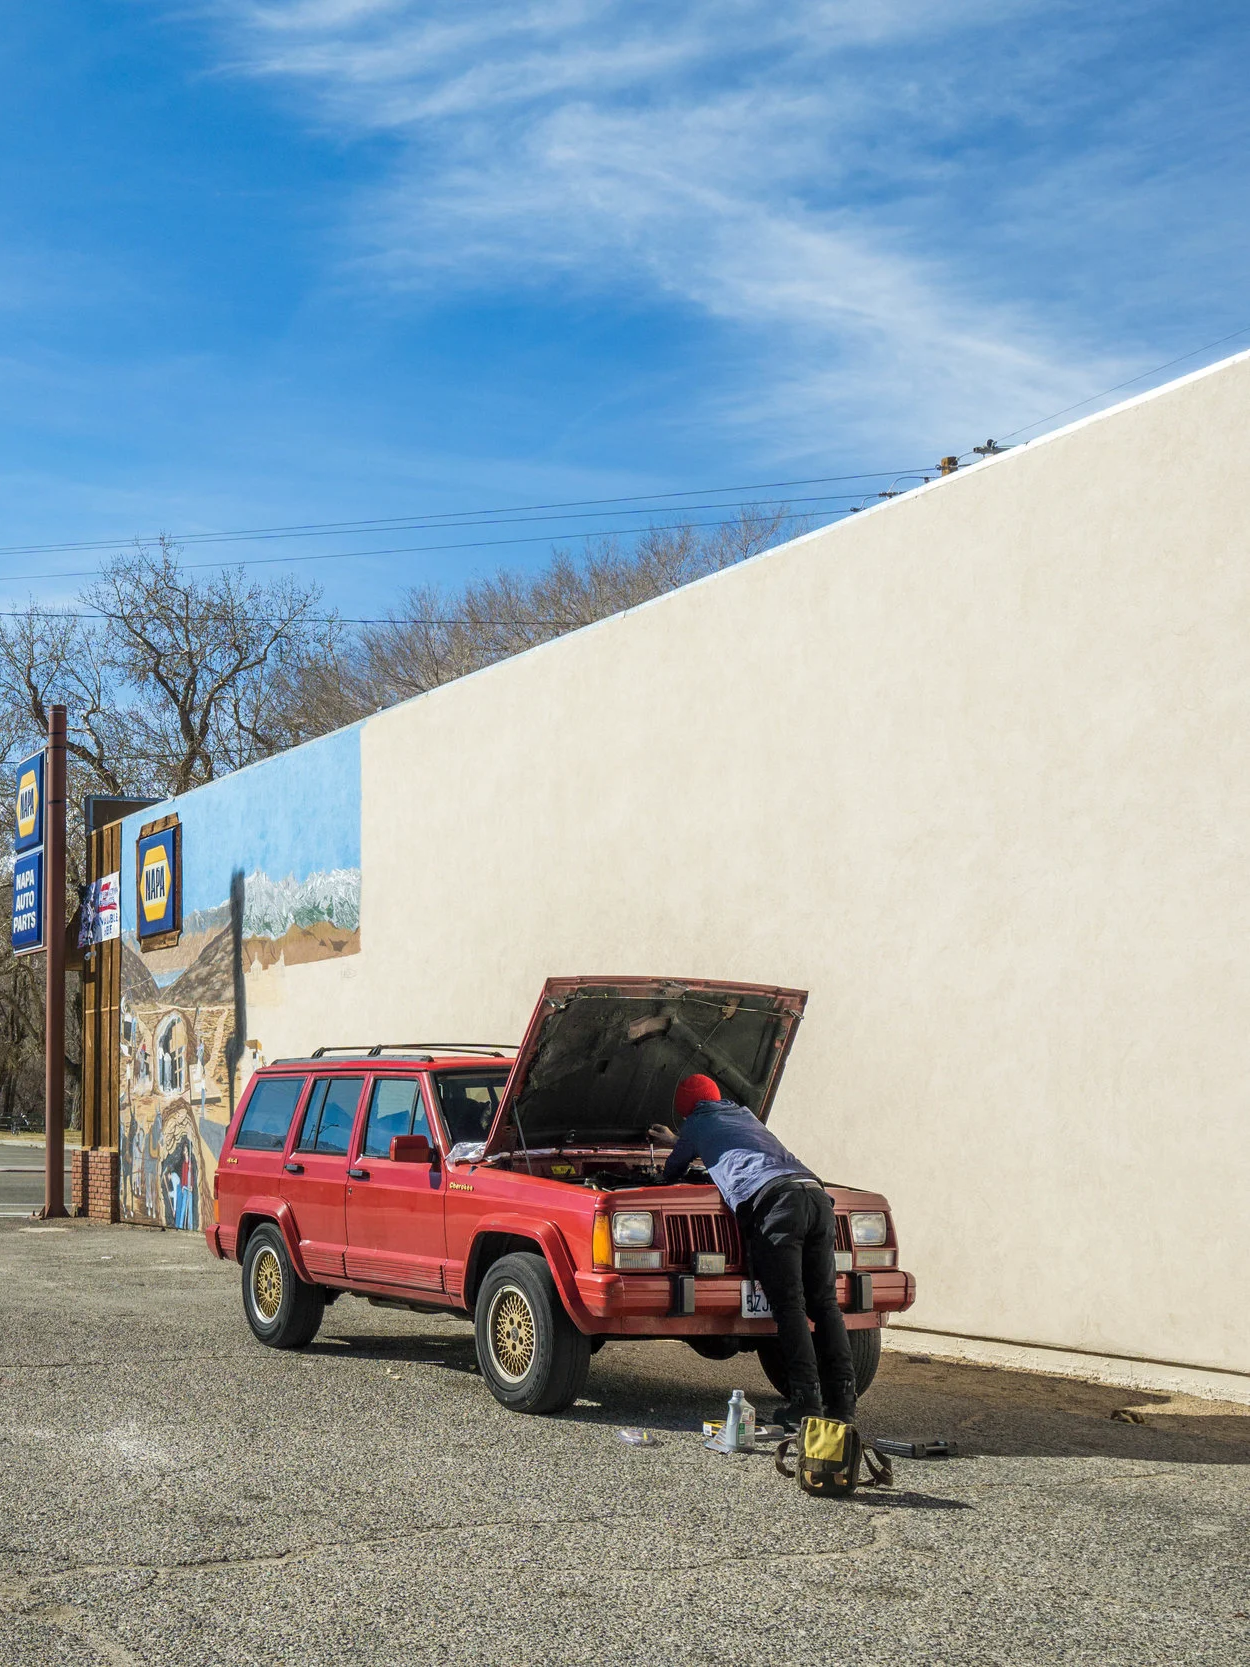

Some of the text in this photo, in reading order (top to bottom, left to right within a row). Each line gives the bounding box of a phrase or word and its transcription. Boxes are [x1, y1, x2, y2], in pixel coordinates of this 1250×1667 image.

[20, 788, 35, 820] NAPA
[16, 869, 35, 891] NAPA
[145, 865, 165, 902] NAPA
[15, 890, 35, 911] AUTO
[13, 911, 36, 934] PARTS
[449, 1181, 474, 1191] Cherokee
